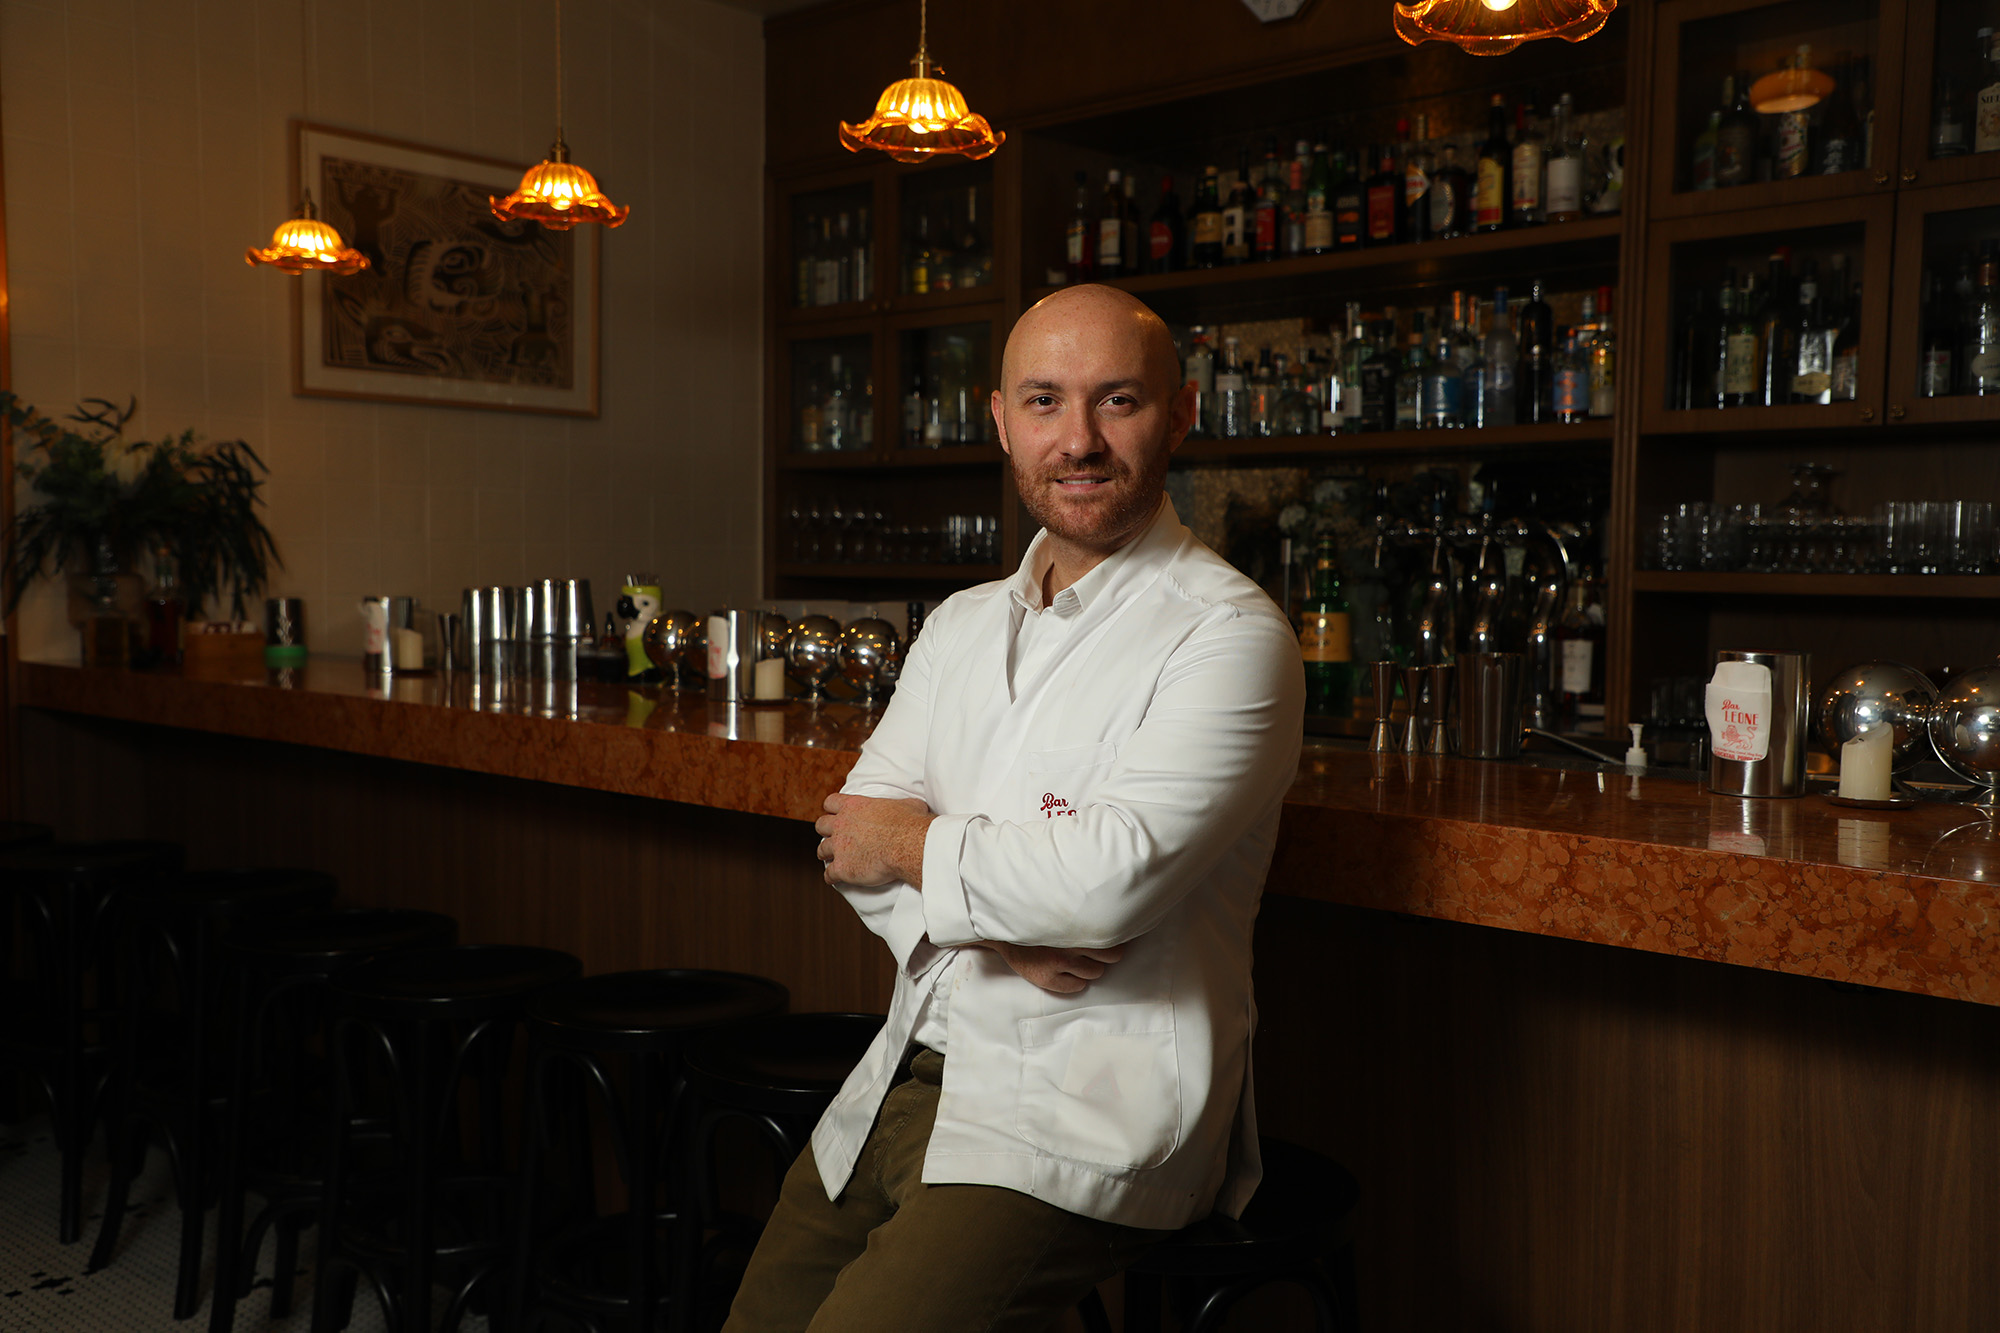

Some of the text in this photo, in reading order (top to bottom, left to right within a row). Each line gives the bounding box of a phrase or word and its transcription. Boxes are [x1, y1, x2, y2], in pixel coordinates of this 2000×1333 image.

[1721, 699, 1740, 710] Bar
[1724, 711, 1759, 725] LEONE
[1040, 792, 1069, 811] Bar
